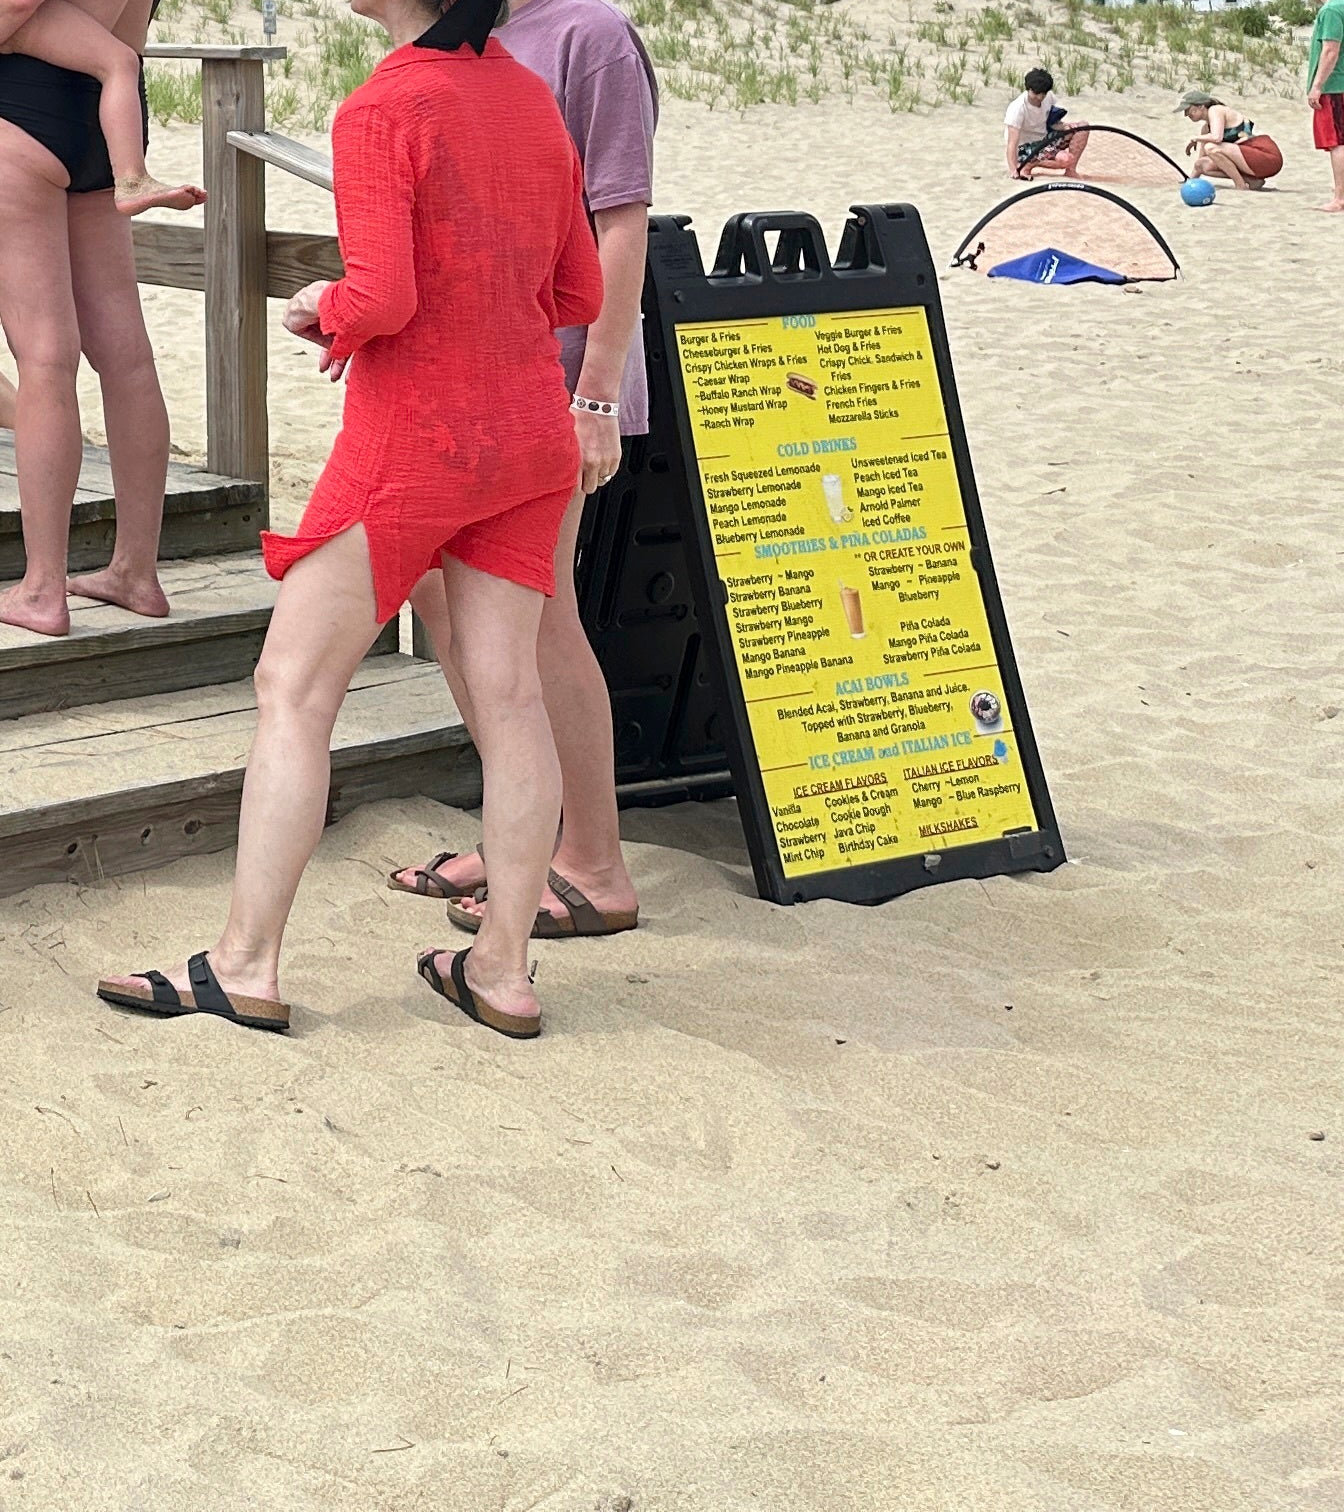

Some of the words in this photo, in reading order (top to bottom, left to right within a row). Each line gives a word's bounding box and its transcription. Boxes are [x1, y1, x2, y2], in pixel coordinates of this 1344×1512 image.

[782, 314, 816, 330] FOOD
[680, 335, 709, 346] Burger
[711, 332, 718, 343] &
[719, 332, 741, 342] Fries
[814, 330, 843, 342] Veggie
[844, 328, 871, 339] Burger
[874, 326, 881, 336] &
[882, 326, 902, 335] Fries
[683, 347, 740, 359] Cheeseburger
[743, 344, 750, 354] &
[751, 344, 773, 354] Fries
[817, 344, 832, 354] Hot
[833, 343, 851, 354] Dog
[852, 342, 859, 351] &
[860, 341, 881, 351] Fries
[685, 363, 712, 374] Crispy
[714, 360, 748, 371] Chicken
[749, 358, 776, 369] Wraps
[778, 356, 785, 366] &
[786, 355, 808, 364] Fries
[824, 385, 857, 396] Chicken
[859, 383, 890, 394] Fingers
[892, 380, 899, 390] &
[900, 379, 921, 389] Fries
[826, 398, 855, 410] French
[856, 397, 877, 407] Fries
[828, 411, 872, 424] Mozzarella
[873, 408, 899, 420] Sticks
[777, 442, 809, 457] COLD
[812, 437, 857, 454] DRINKS
[851, 453, 909, 468] Unsweetened
[910, 451, 930, 462] Iced
[930, 450, 947, 460] Tea
[704, 472, 730, 484] Fresh
[731, 467, 774, 482] Squeezed
[775, 462, 821, 476] Lemonade
[854, 470, 881, 483] Peach
[882, 468, 901, 480] Iced
[902, 468, 918, 478] Tea
[707, 486, 754, 499] Strawberry
[756, 480, 802, 494] Lemonade
[856, 487, 886, 498] Mango
[887, 483, 907, 494] Iced
[907, 482, 924, 492] Tea
[860, 500, 889, 513] Arnold
[890, 498, 921, 509] Palmer
[862, 516, 881, 527] Iced
[883, 513, 911, 525] Coffee
[715, 532, 757, 545] Blueberry
[759, 525, 805, 540] Lemonade
[754, 538, 826, 558] SMOOTHIES
[828, 536, 839, 550] &
[872, 526, 927, 544] COLADAS
[864, 551, 878, 562] OR
[879, 547, 915, 560] CREATE
[915, 544, 942, 555] YOUR
[943, 541, 965, 553] OWN
[898, 590, 939, 602] Blueberry
[732, 604, 779, 618] Strawberry
[781, 598, 823, 611] Blueberry
[921, 616, 951, 629] Colada
[739, 635, 785, 649] Strawberry
[787, 627, 830, 642] Pineapple
[865, 672, 909, 691] BOWLS
[777, 704, 814, 720] Blended
[890, 690, 924, 703] Banana
[926, 685, 943, 697] and
[801, 717, 835, 733] Topped
[836, 714, 856, 727] with
[837, 730, 871, 743] Banana
[872, 724, 889, 737] and
[891, 720, 926, 734] Granola
[809, 754, 830, 770] ICE
[832, 746, 875, 770] CREAM
[879, 743, 900, 759] and
[901, 735, 949, 755] ITALIAN
[951, 731, 972, 747] ICE
[793, 785, 811, 799] ICE
[810, 779, 844, 796] CREAM
[845, 772, 887, 789] FLAVORS
[825, 794, 860, 809] Cookies
[862, 791, 869, 802] &
[870, 788, 898, 800] Cream
[772, 803, 802, 817] Vanilla
[831, 808, 861, 823] Cookie
[862, 803, 892, 817] Dough
[776, 816, 820, 833] Chocolate
[834, 827, 854, 839] Java
[855, 822, 876, 835] Chip
[918, 816, 979, 838] MILKSHAKES
[779, 832, 826, 849] Strawberry
